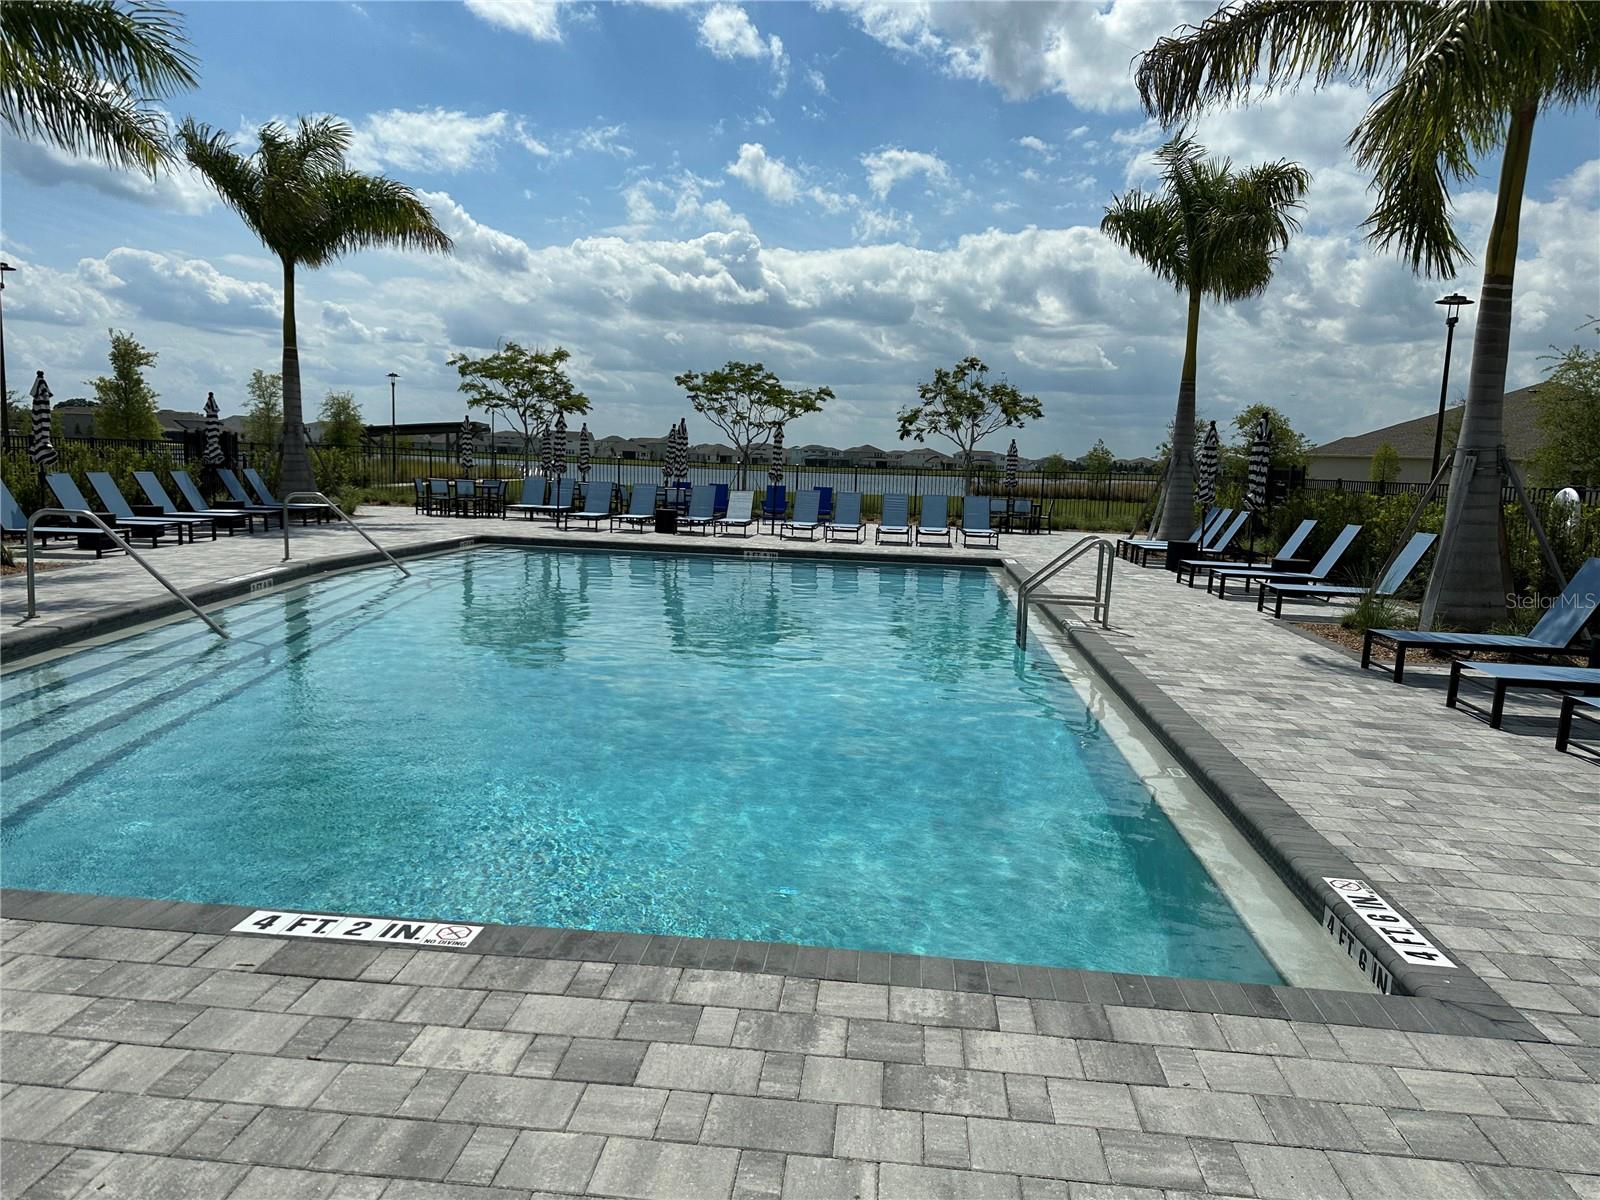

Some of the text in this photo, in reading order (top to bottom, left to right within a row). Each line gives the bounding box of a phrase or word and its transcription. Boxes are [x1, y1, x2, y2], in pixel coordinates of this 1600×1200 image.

[252, 915, 425, 940] 4 FT. 2 IN.
[1327, 914, 1335, 936] 4
[1358, 948, 1368, 972] 6
[1346, 894, 1439, 961] 4 FT. 6 IN.
